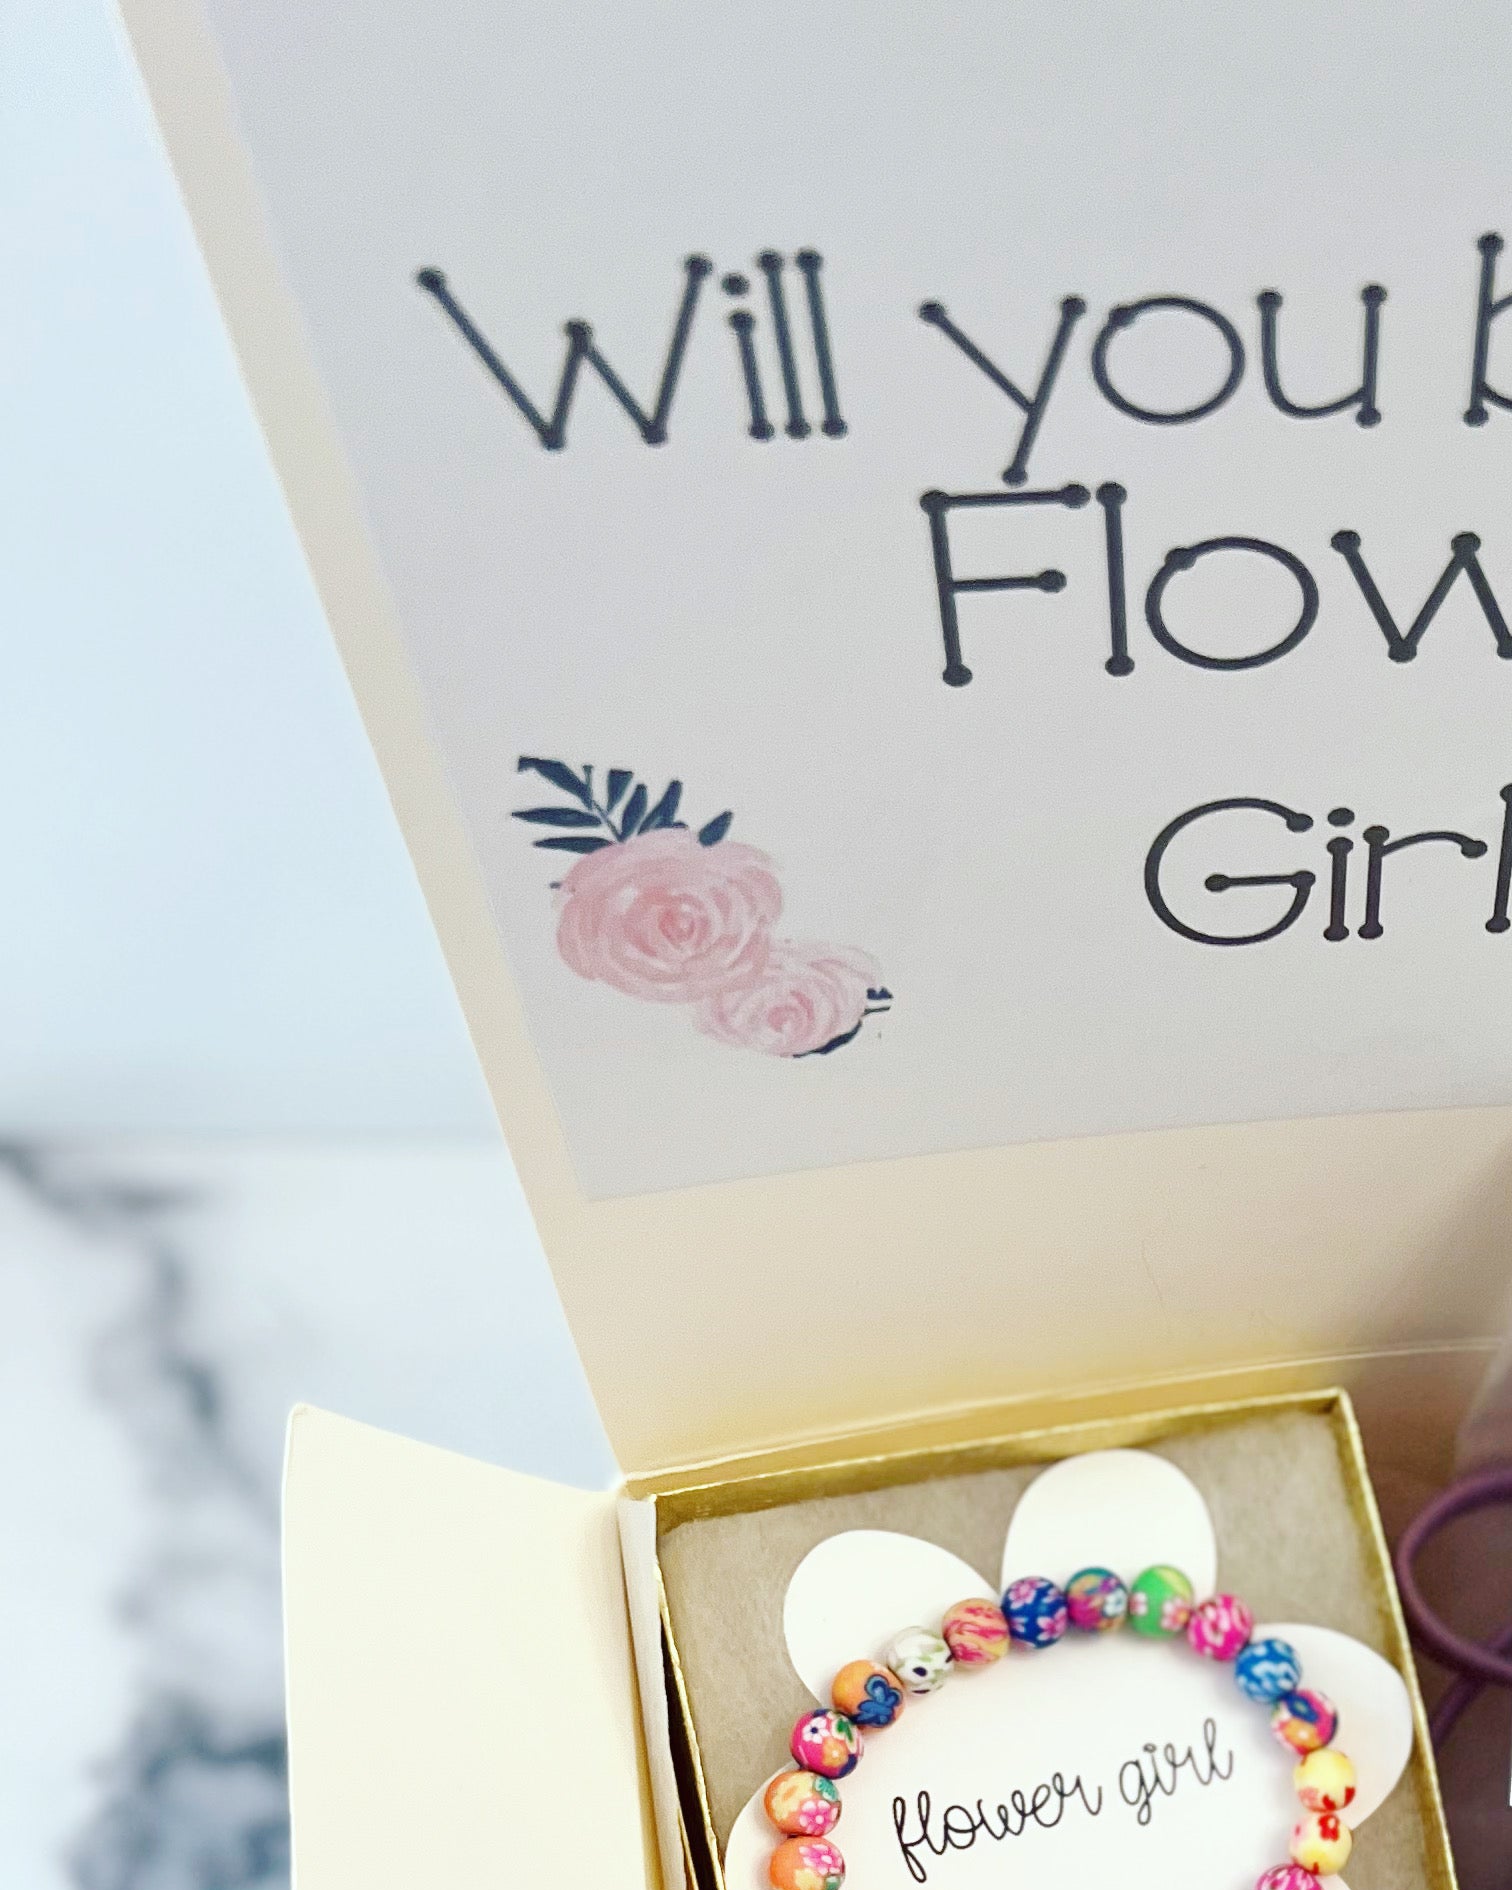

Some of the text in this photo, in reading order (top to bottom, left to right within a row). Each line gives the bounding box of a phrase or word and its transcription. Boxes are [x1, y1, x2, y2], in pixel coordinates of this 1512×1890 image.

[418, 250, 847, 451] Will
[919, 285, 1387, 486] you
[892, 1719, 1232, 1883] flower girl
